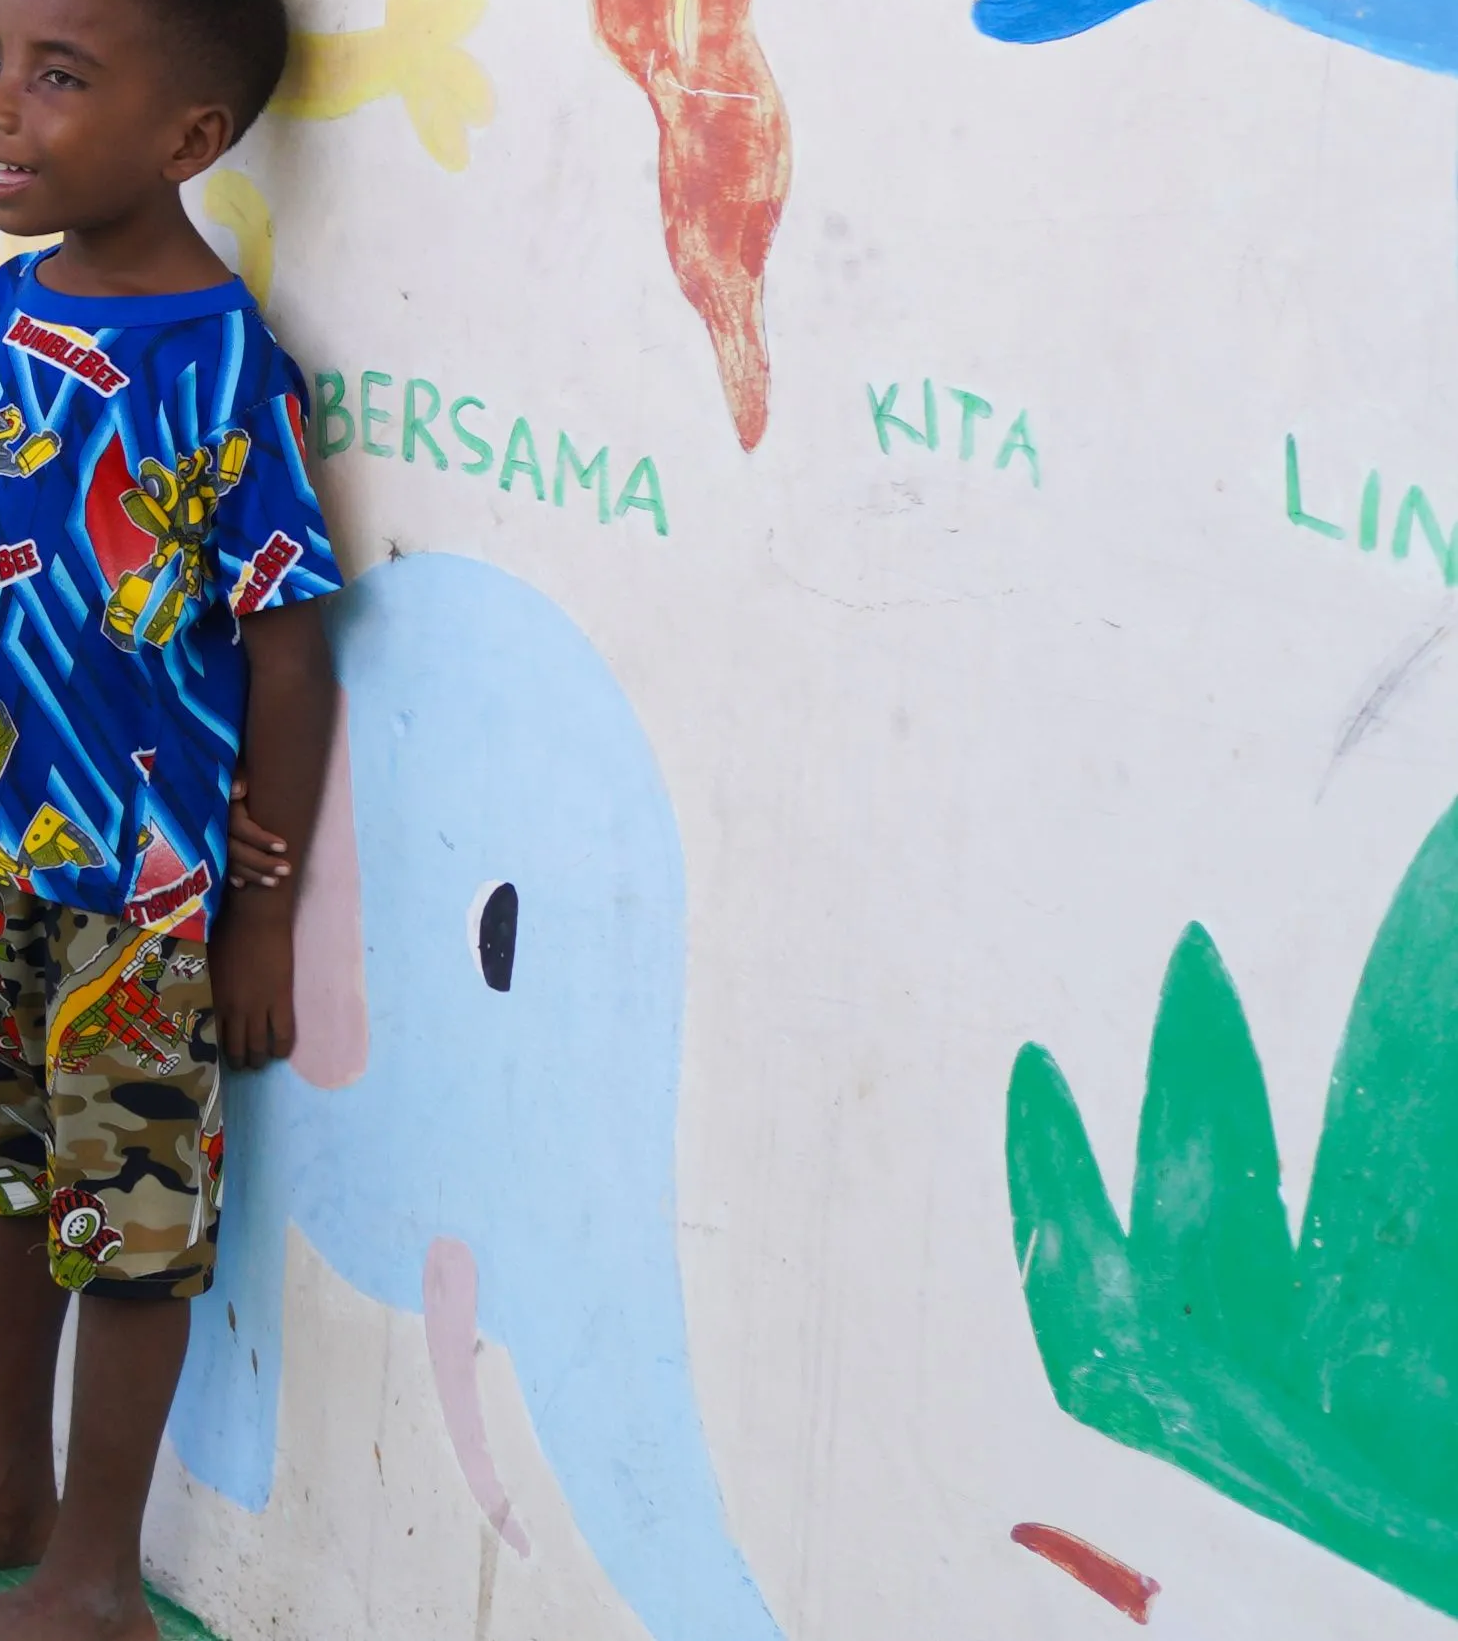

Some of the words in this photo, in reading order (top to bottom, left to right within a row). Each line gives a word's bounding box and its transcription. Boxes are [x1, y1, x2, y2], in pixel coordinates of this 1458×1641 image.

[7, 314, 126, 393] BUMBLEBEE
[313, 368, 669, 537] BERSAMA
[865, 377, 1041, 491] KITA
